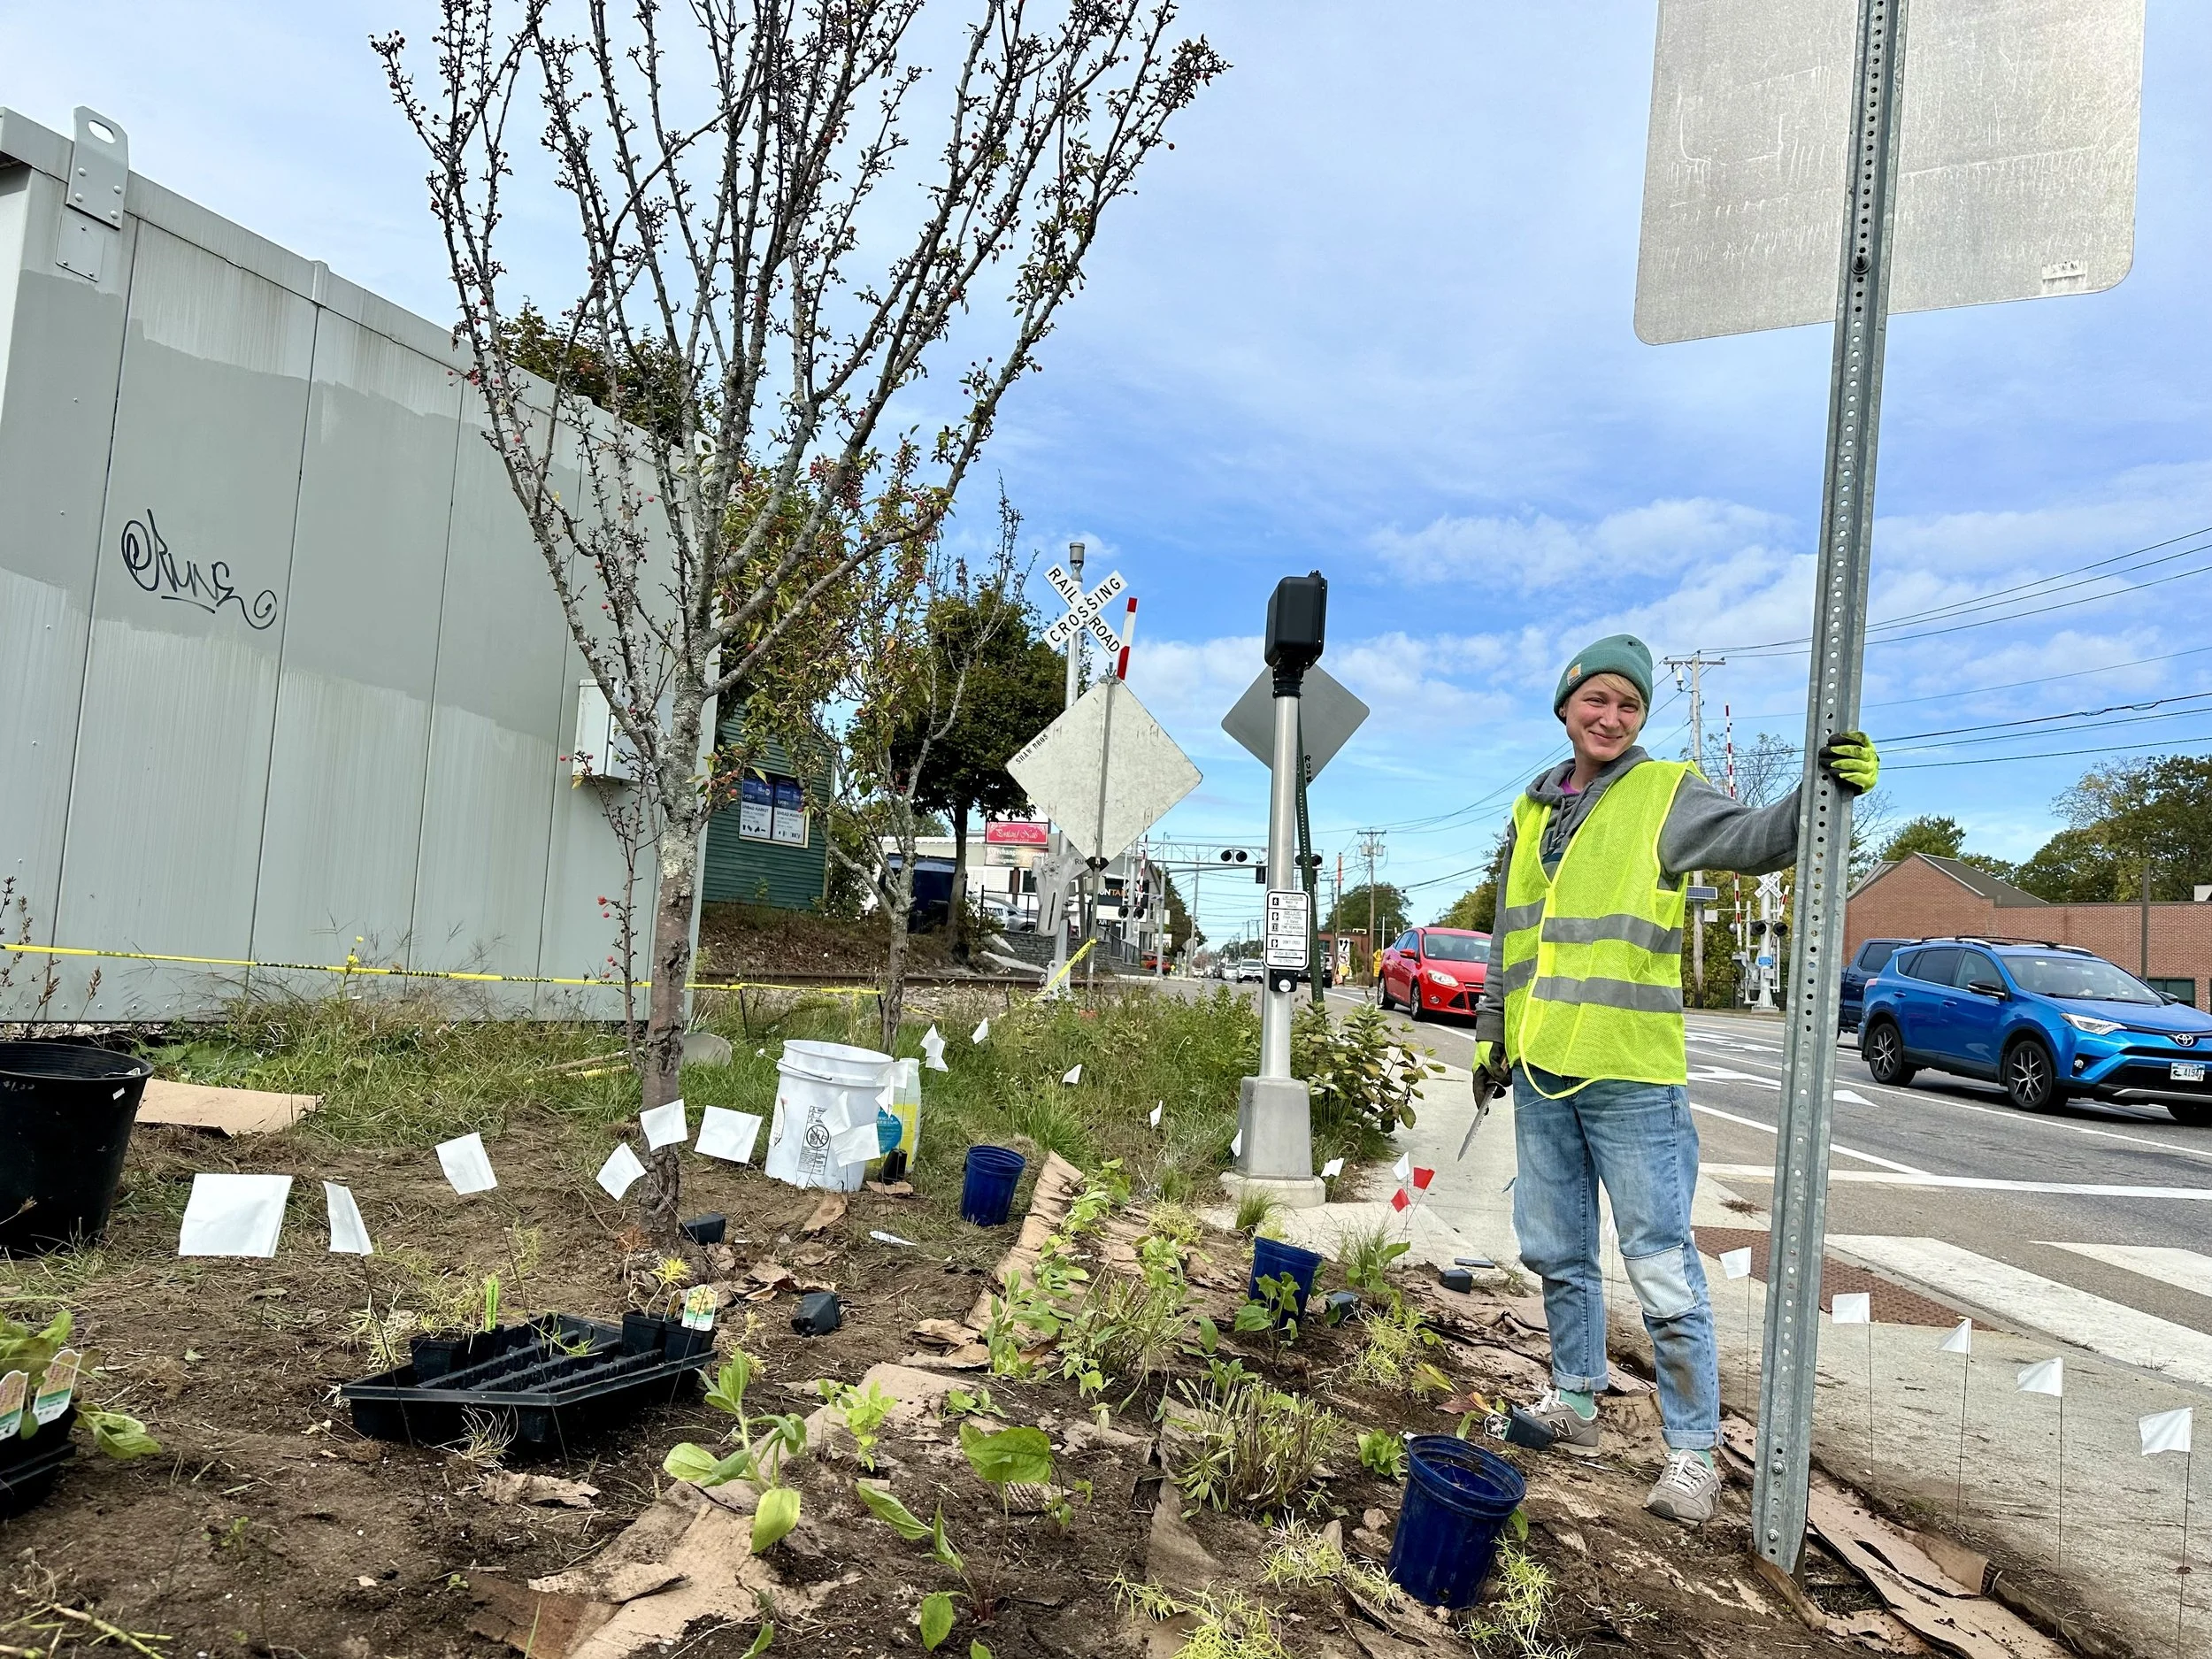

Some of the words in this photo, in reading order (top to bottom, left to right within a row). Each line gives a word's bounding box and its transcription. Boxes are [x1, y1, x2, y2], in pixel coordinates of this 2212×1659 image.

[1048, 567, 1079, 603] RAIL
[1049, 578, 1121, 642] CROSSING
[1088, 616, 1120, 653] ROAD
[1756, 872, 1781, 896] CROSSING
[1548, 1417, 1572, 1437] N
